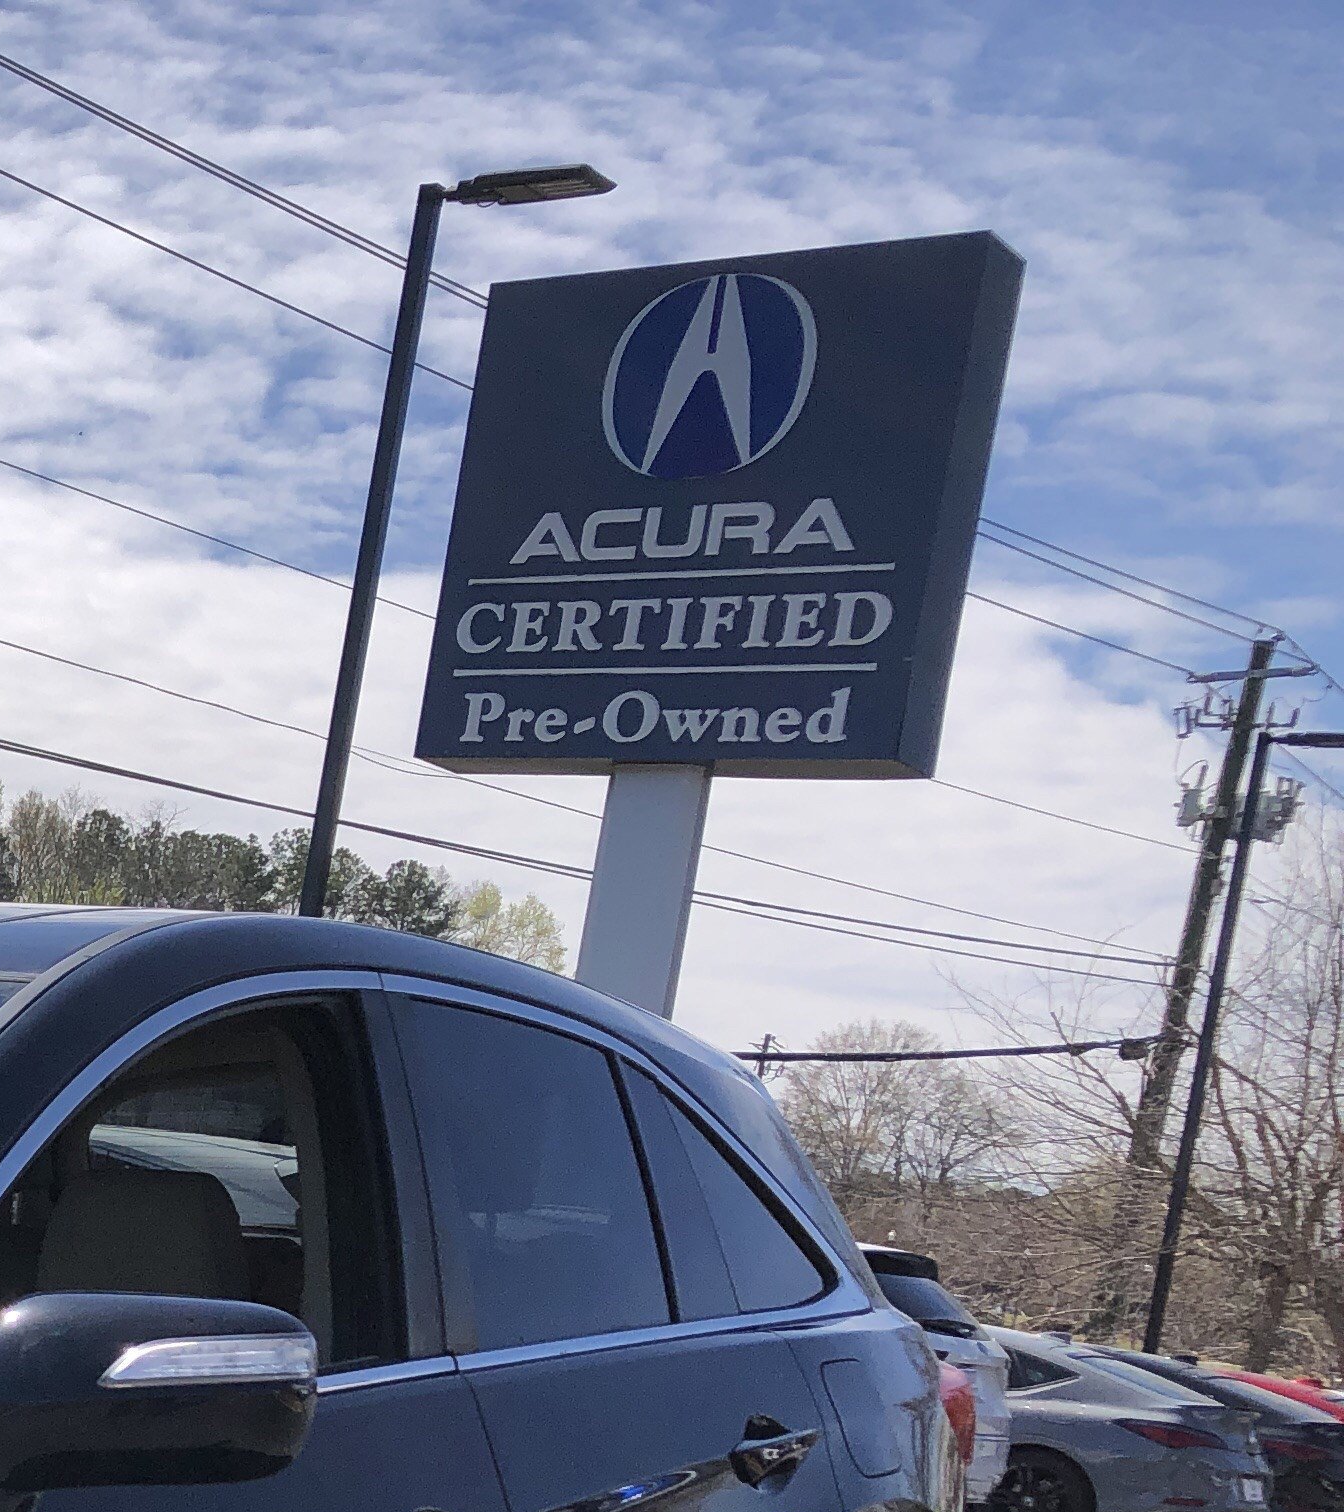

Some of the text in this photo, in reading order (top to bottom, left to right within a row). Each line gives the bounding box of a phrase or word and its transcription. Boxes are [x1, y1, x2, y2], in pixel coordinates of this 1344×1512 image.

[510, 498, 855, 565] ACURA
[456, 591, 894, 654] CERTIFIED
[459, 687, 852, 744] Pre-Owned
